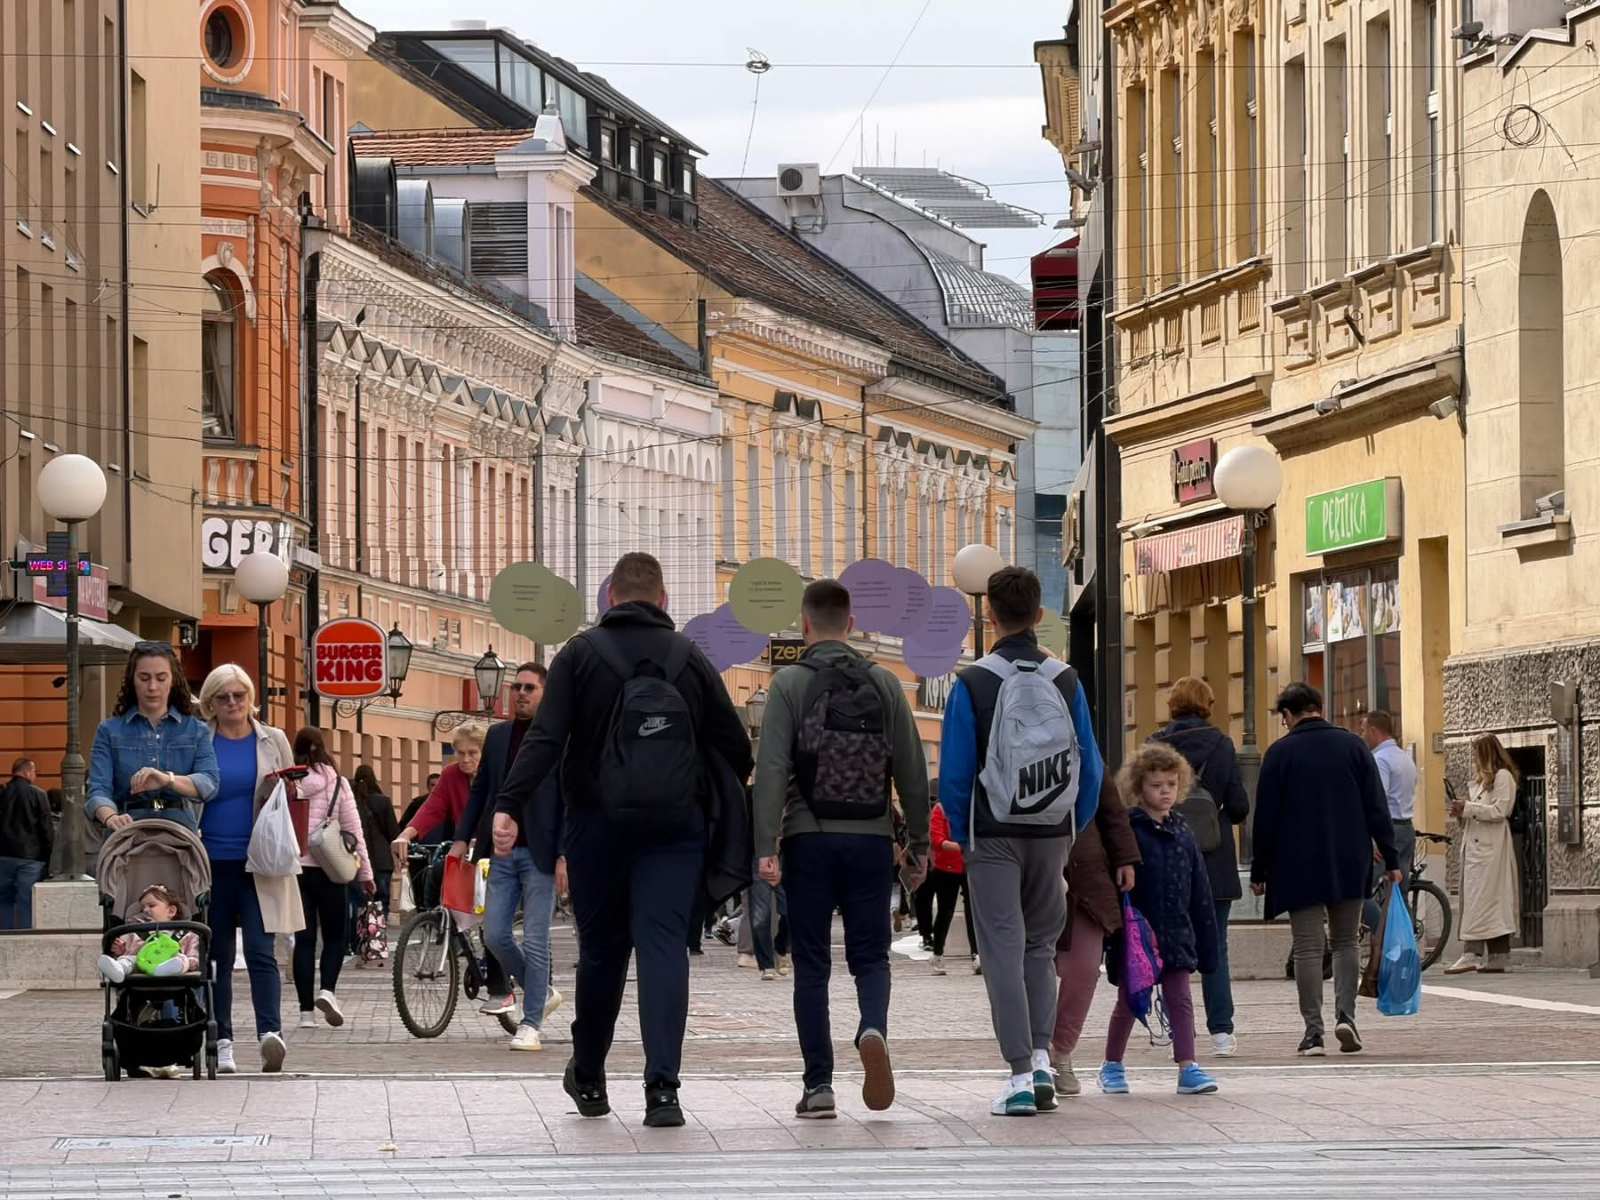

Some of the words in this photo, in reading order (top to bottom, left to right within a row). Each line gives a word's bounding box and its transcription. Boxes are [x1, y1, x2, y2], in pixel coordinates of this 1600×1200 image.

[28, 560, 54, 571] WEB
[316, 644, 382, 660] BURGER
[316, 660, 382, 681] KING
[1018, 749, 1071, 800] NIKE
